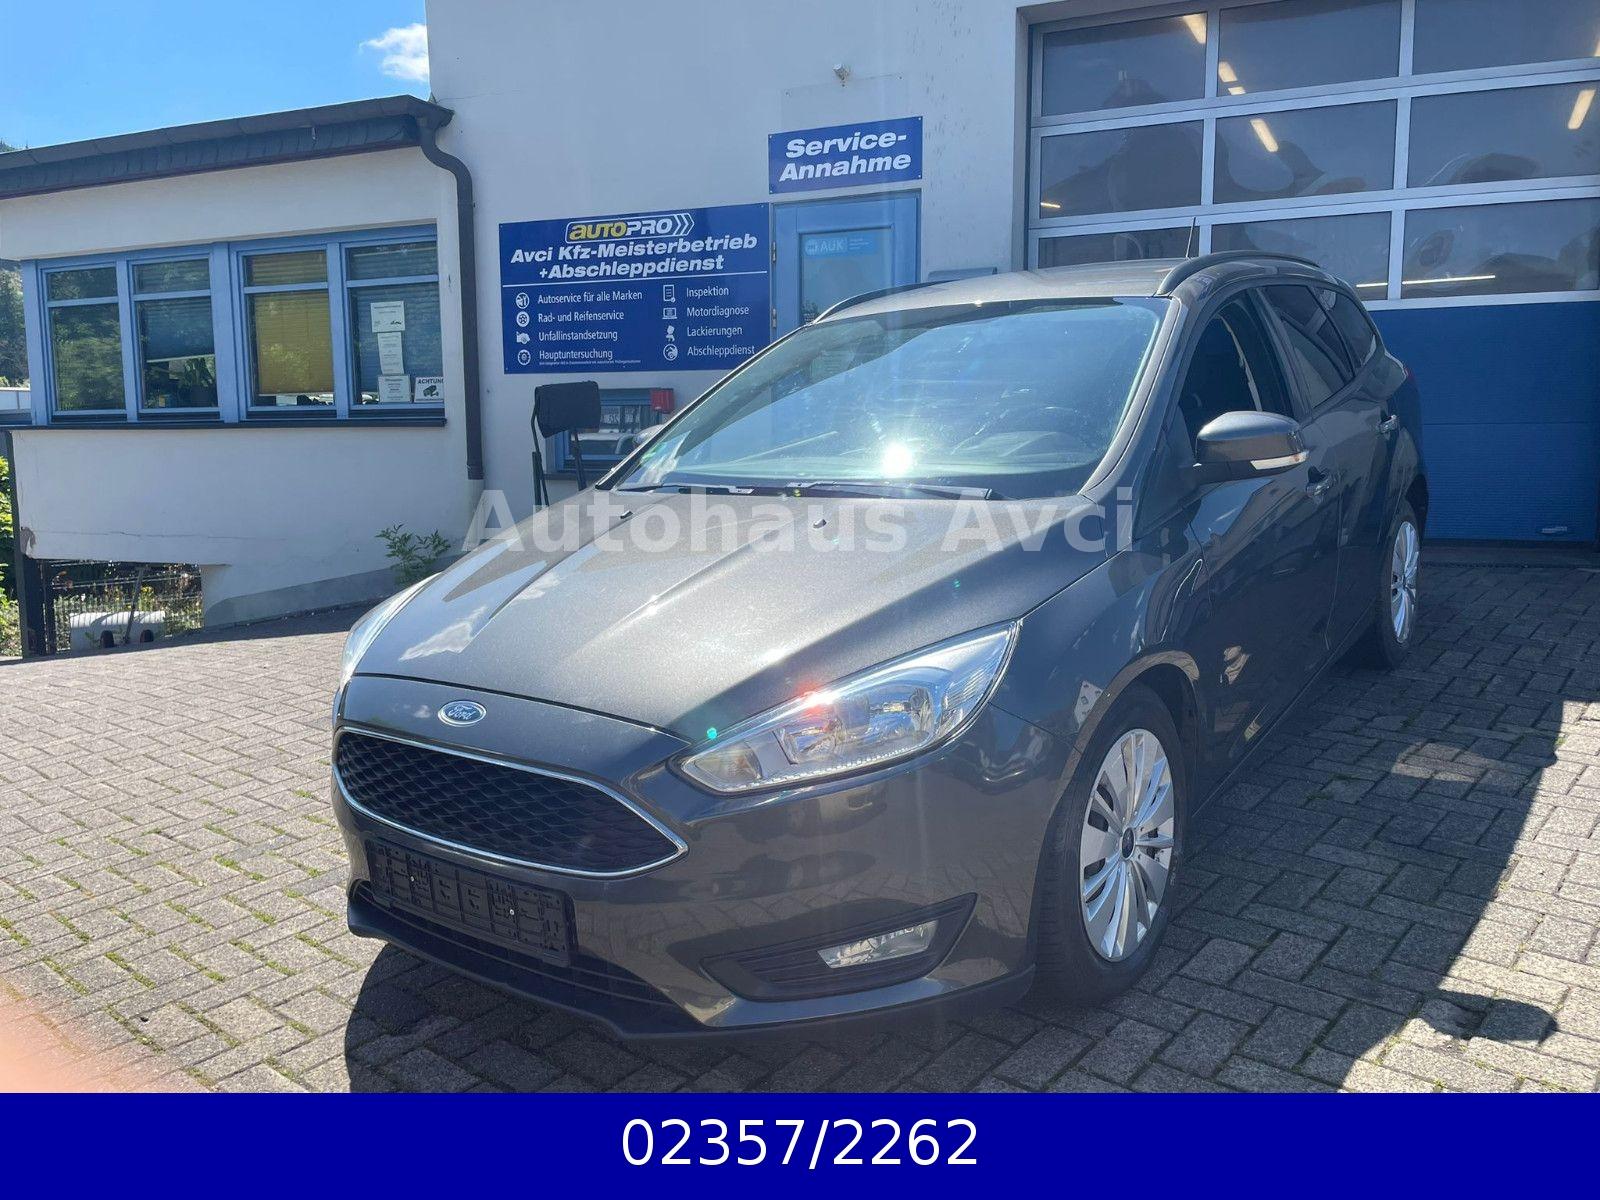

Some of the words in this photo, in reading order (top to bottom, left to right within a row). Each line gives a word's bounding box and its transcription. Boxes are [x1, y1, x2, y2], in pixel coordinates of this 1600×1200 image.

[786, 131, 907, 159] Service-
[779, 153, 912, 182] Annahme
[510, 247, 553, 264] Avci
[558, 233, 758, 261] Kfz-Meisterbetrieb
[539, 255, 724, 280] +Abschleppdienst
[537, 293, 582, 304] Autoservice
[583, 292, 595, 303] für
[596, 292, 611, 302] alle
[612, 290, 643, 302] Marken
[686, 286, 729, 300] Inspektion
[538, 313, 556, 323] Rad-
[557, 312, 572, 322] und
[573, 311, 625, 321] Reifenservice
[686, 305, 750, 319] Motordiagnose
[538, 330, 618, 342] Unfallinstandsetzung
[686, 326, 743, 338] Lackierungen
[539, 349, 613, 361] Hauptuntersuchung
[687, 344, 756, 358] Abschleppdienst
[447, 703, 477, 720] Ford
